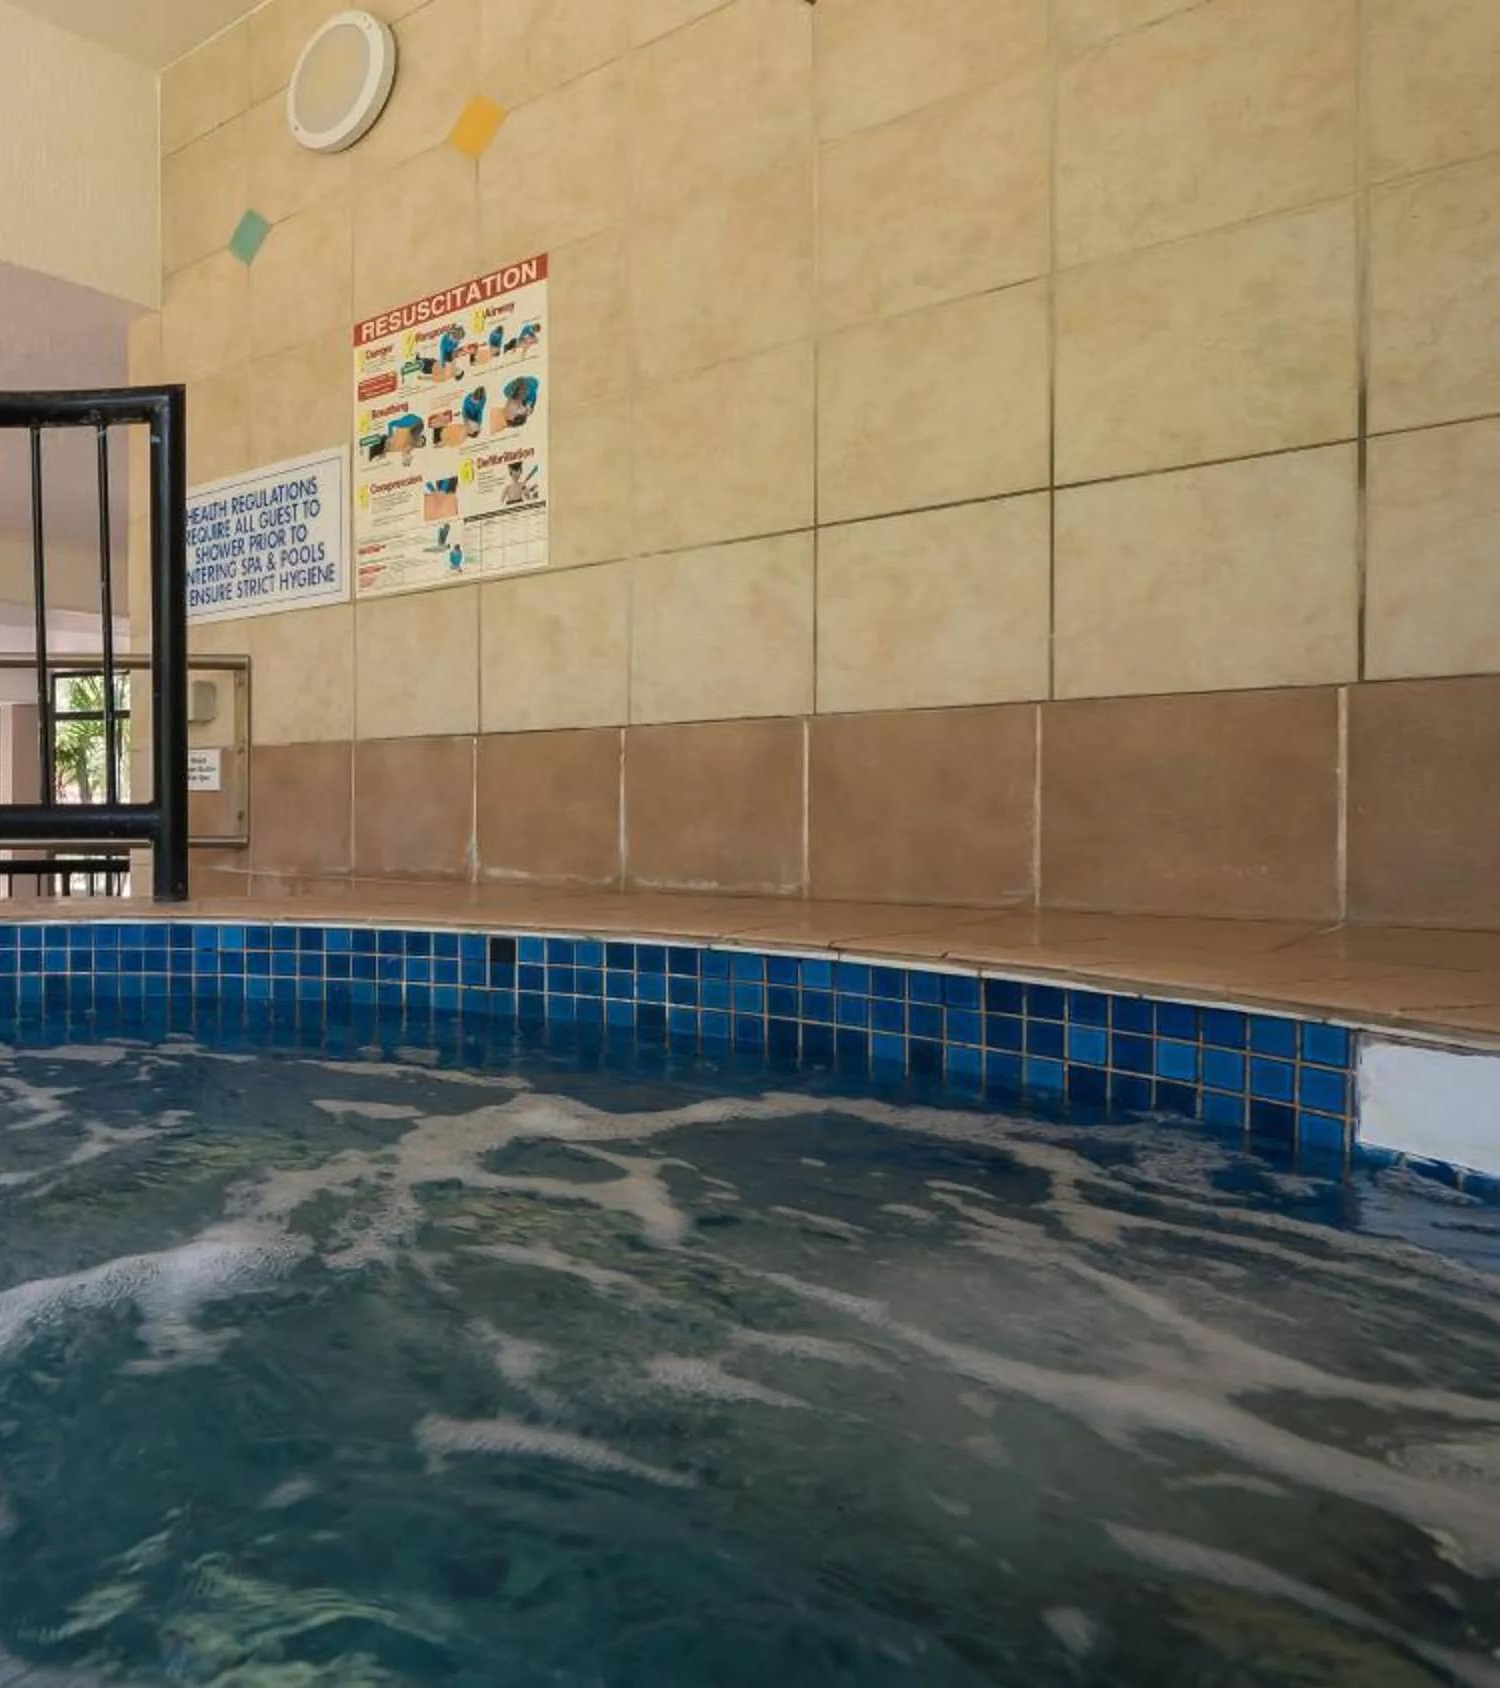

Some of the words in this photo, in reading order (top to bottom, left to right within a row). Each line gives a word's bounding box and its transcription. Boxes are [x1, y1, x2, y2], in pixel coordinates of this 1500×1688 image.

[361, 258, 538, 341] RESUSCITATION
[232, 477, 317, 513] REGULATIONS
[235, 517, 254, 535] ALL
[259, 505, 297, 528] GUEST
[303, 500, 320, 518] TO
[187, 561, 236, 585] NTERING
[241, 556, 262, 575] SPA
[266, 552, 276, 570] &
[281, 543, 324, 566] POOLS
[195, 540, 244, 564] SHOWER
[250, 530, 285, 554] PRIOR
[290, 525, 307, 543] TO
[190, 583, 232, 606] ENSURE
[237, 576, 274, 598] STRICT
[279, 564, 335, 591] HYGIENE
